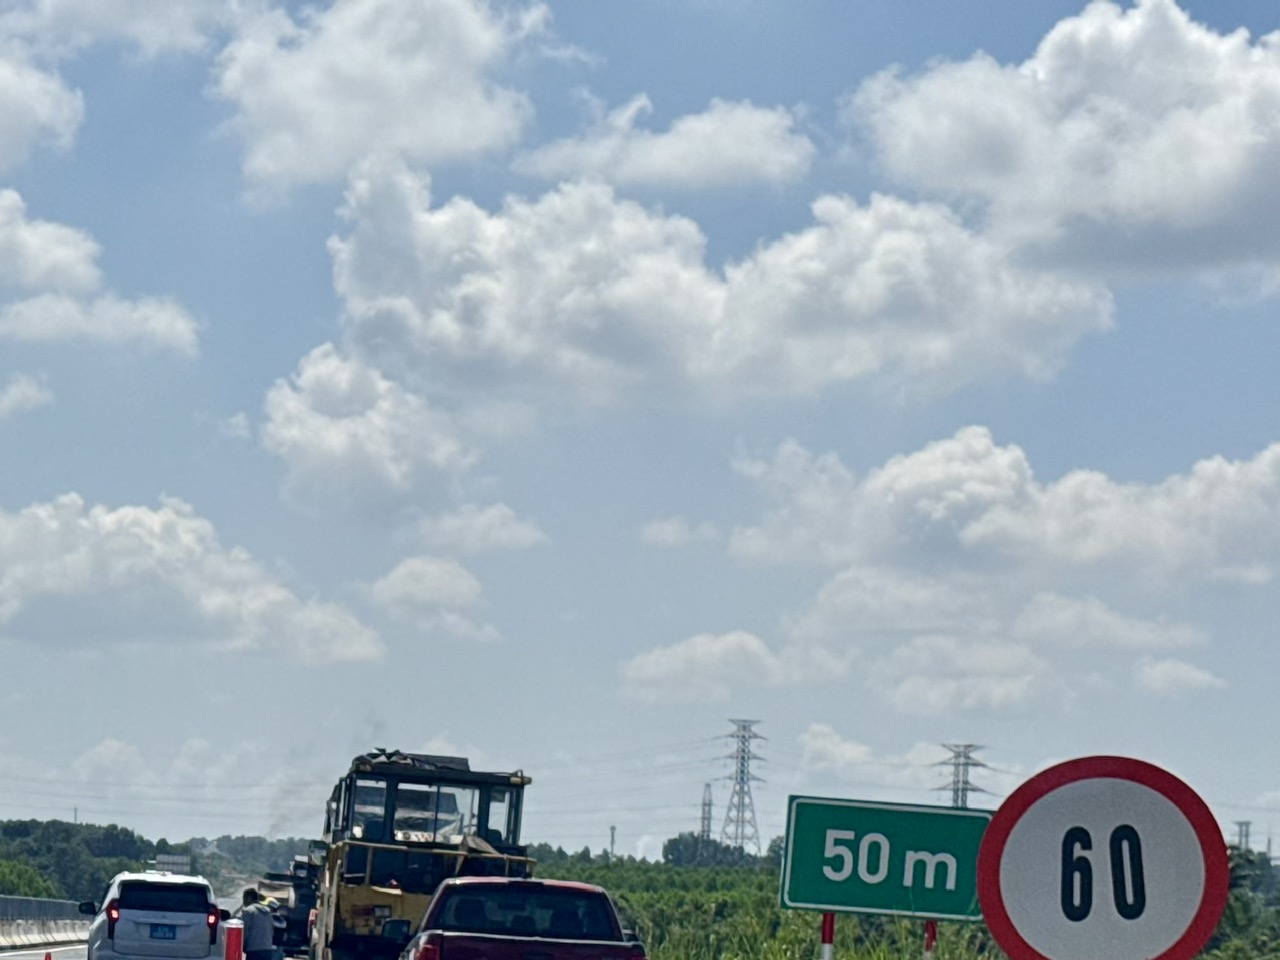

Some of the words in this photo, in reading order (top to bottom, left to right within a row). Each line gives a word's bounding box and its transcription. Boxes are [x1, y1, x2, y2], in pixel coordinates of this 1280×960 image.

[822, 829, 890, 884] 50
[903, 849, 957, 891] m
[1061, 824, 1146, 922] 60
